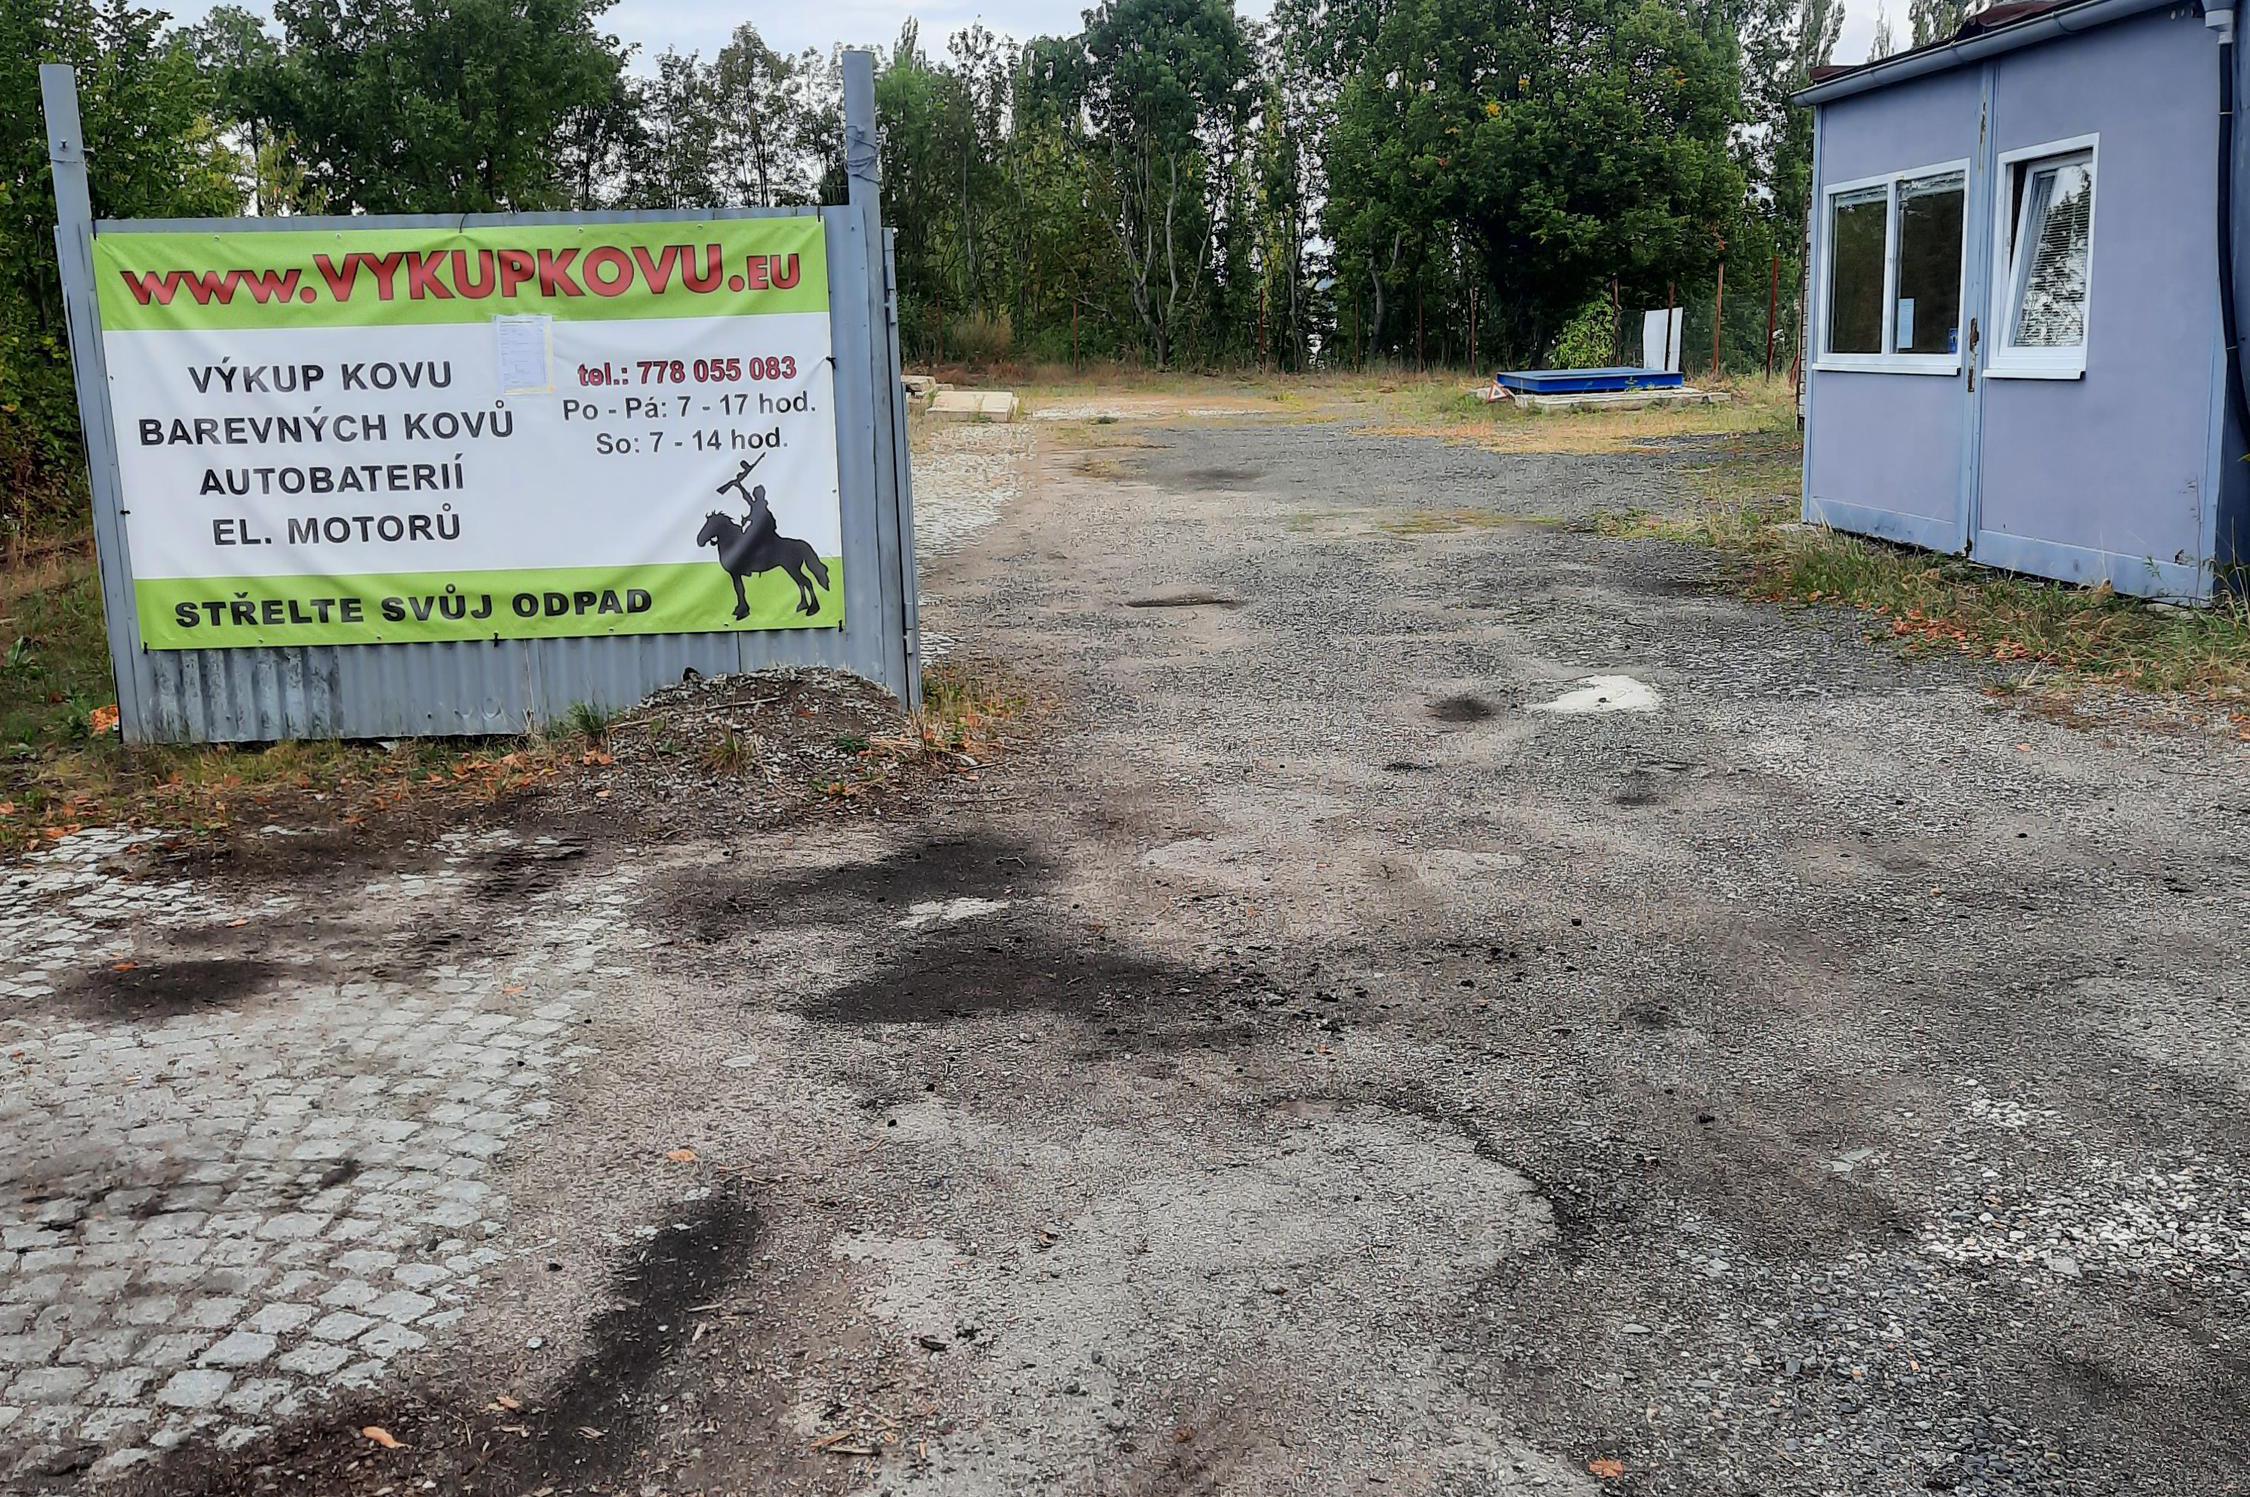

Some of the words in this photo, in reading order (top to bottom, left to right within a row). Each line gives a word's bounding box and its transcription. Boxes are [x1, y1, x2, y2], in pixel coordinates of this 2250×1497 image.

[119, 243, 801, 305] www.VYKUPKOVU.EU
[188, 356, 324, 393] VÝKUP
[341, 361, 452, 390] KOVU
[577, 362, 629, 387] tel.:
[636, 360, 687, 385] 778
[693, 358, 742, 383] 055
[749, 356, 798, 380] 083
[138, 406, 387, 446] BAREVNÝCH
[404, 399, 513, 441] KOVŮ
[562, 399, 599, 421] Po
[625, 396, 668, 419] Pá:
[676, 396, 692, 417] 7
[720, 394, 749, 416] 17
[758, 391, 817, 414] hod.
[596, 432, 641, 455] So:
[649, 431, 664, 453] 7
[692, 429, 722, 451] 14
[731, 427, 789, 449] hod.
[200, 453, 464, 496] AUTOBATERIÍ
[212, 518, 272, 545] EL.
[288, 503, 460, 545] MOTORŮ
[175, 592, 363, 628] STŘELTE
[382, 584, 493, 621] SVŮJ
[512, 588, 652, 618] ODPAD
